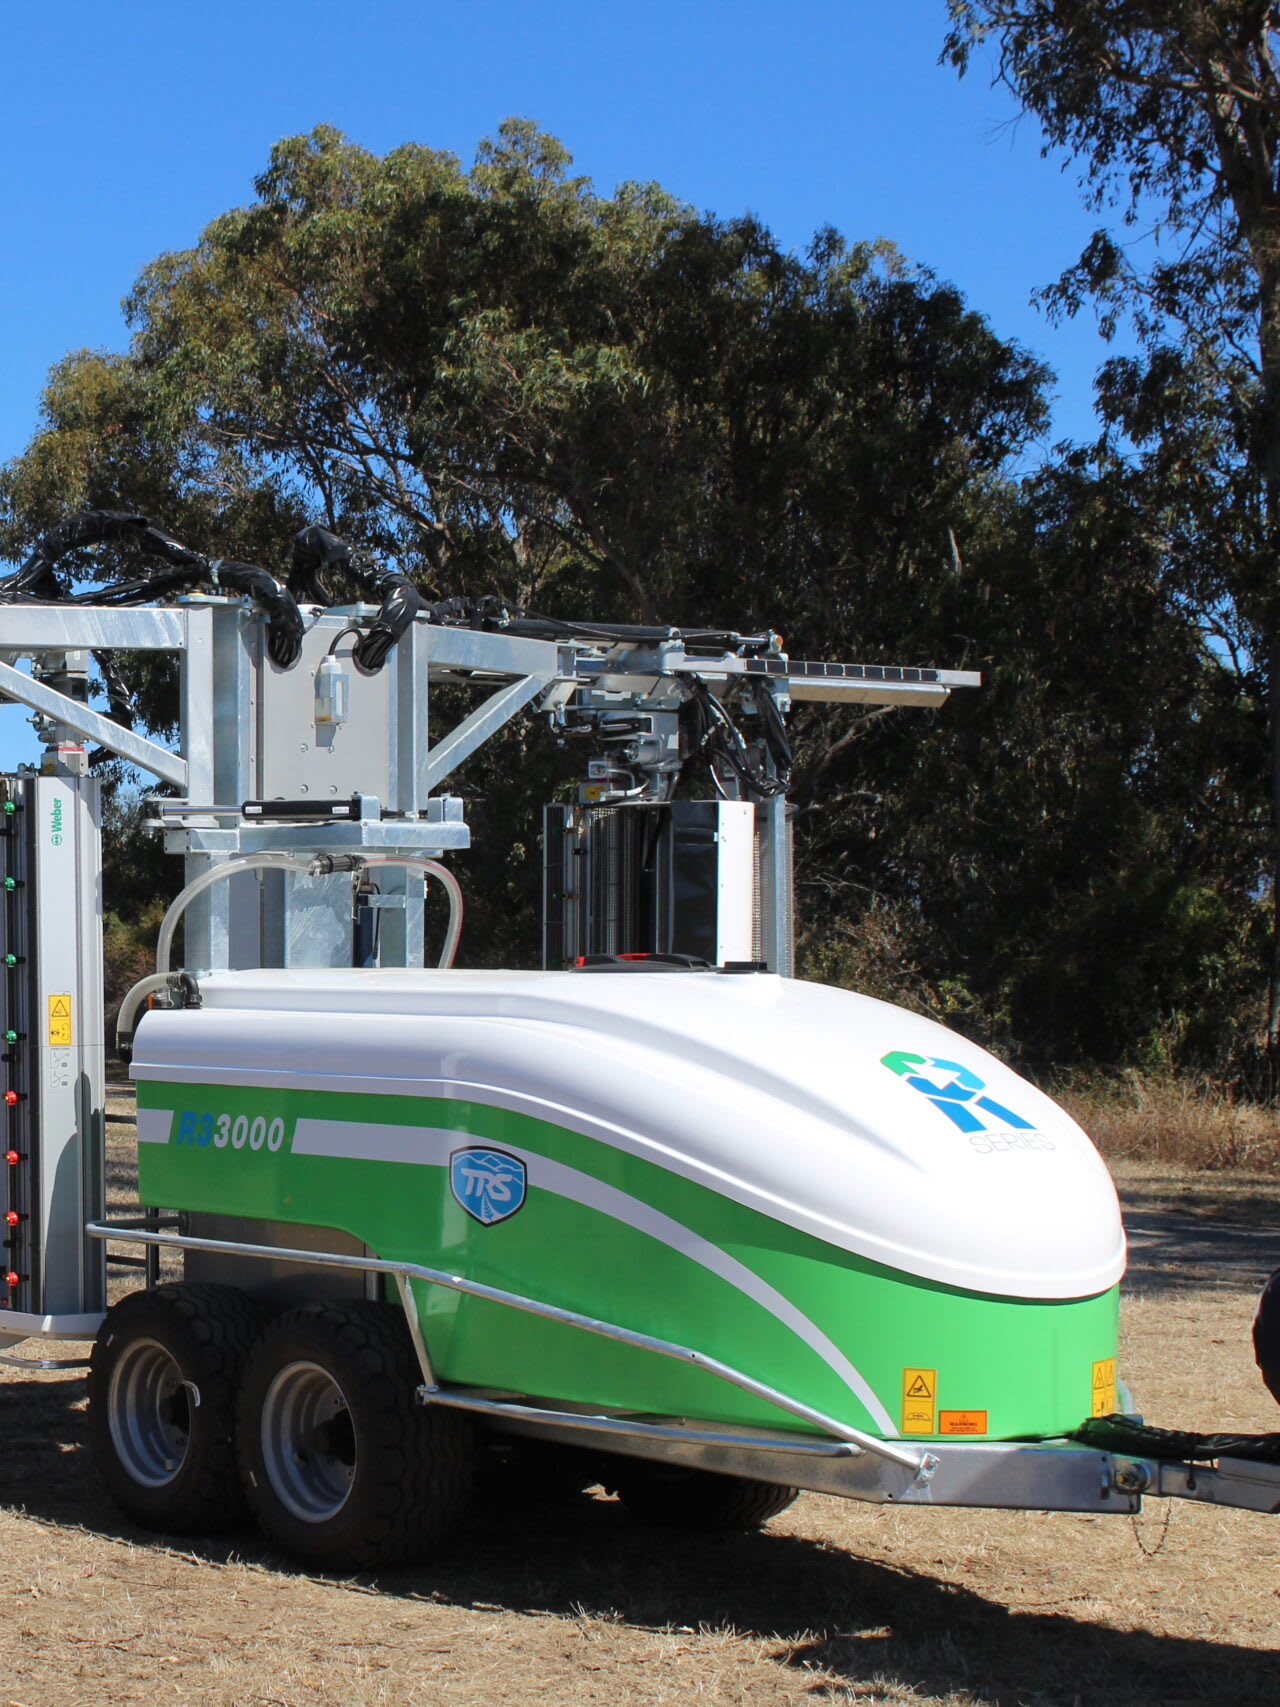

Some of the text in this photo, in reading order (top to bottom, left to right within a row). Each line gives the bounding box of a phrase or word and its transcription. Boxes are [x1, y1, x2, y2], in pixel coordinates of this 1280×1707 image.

[50, 798, 62, 833] Weber
[969, 1132, 1056, 1154] SERIES
[460, 1167, 513, 1202] TRS
